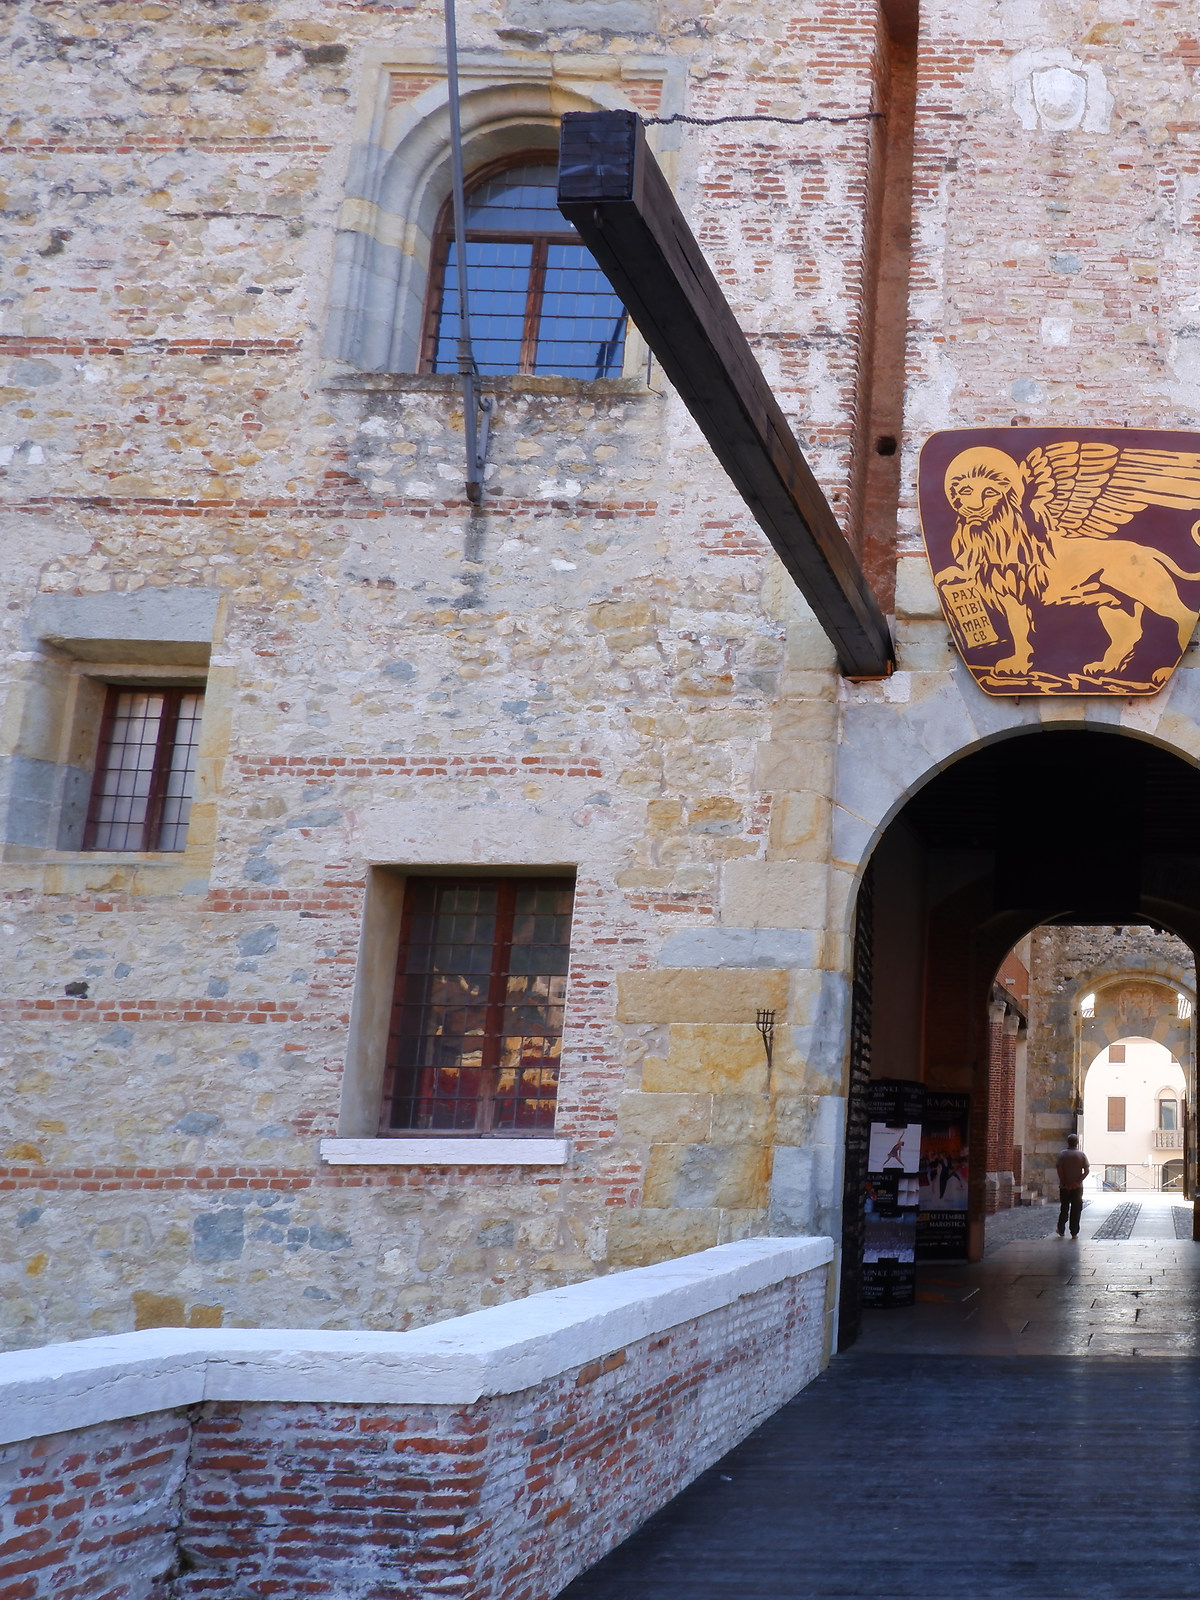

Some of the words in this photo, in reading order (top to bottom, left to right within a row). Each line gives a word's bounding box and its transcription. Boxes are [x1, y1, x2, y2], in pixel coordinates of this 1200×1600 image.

[951, 586, 977, 603] PAX
[956, 600, 984, 617] TIBI
[962, 616, 990, 633] MAR
